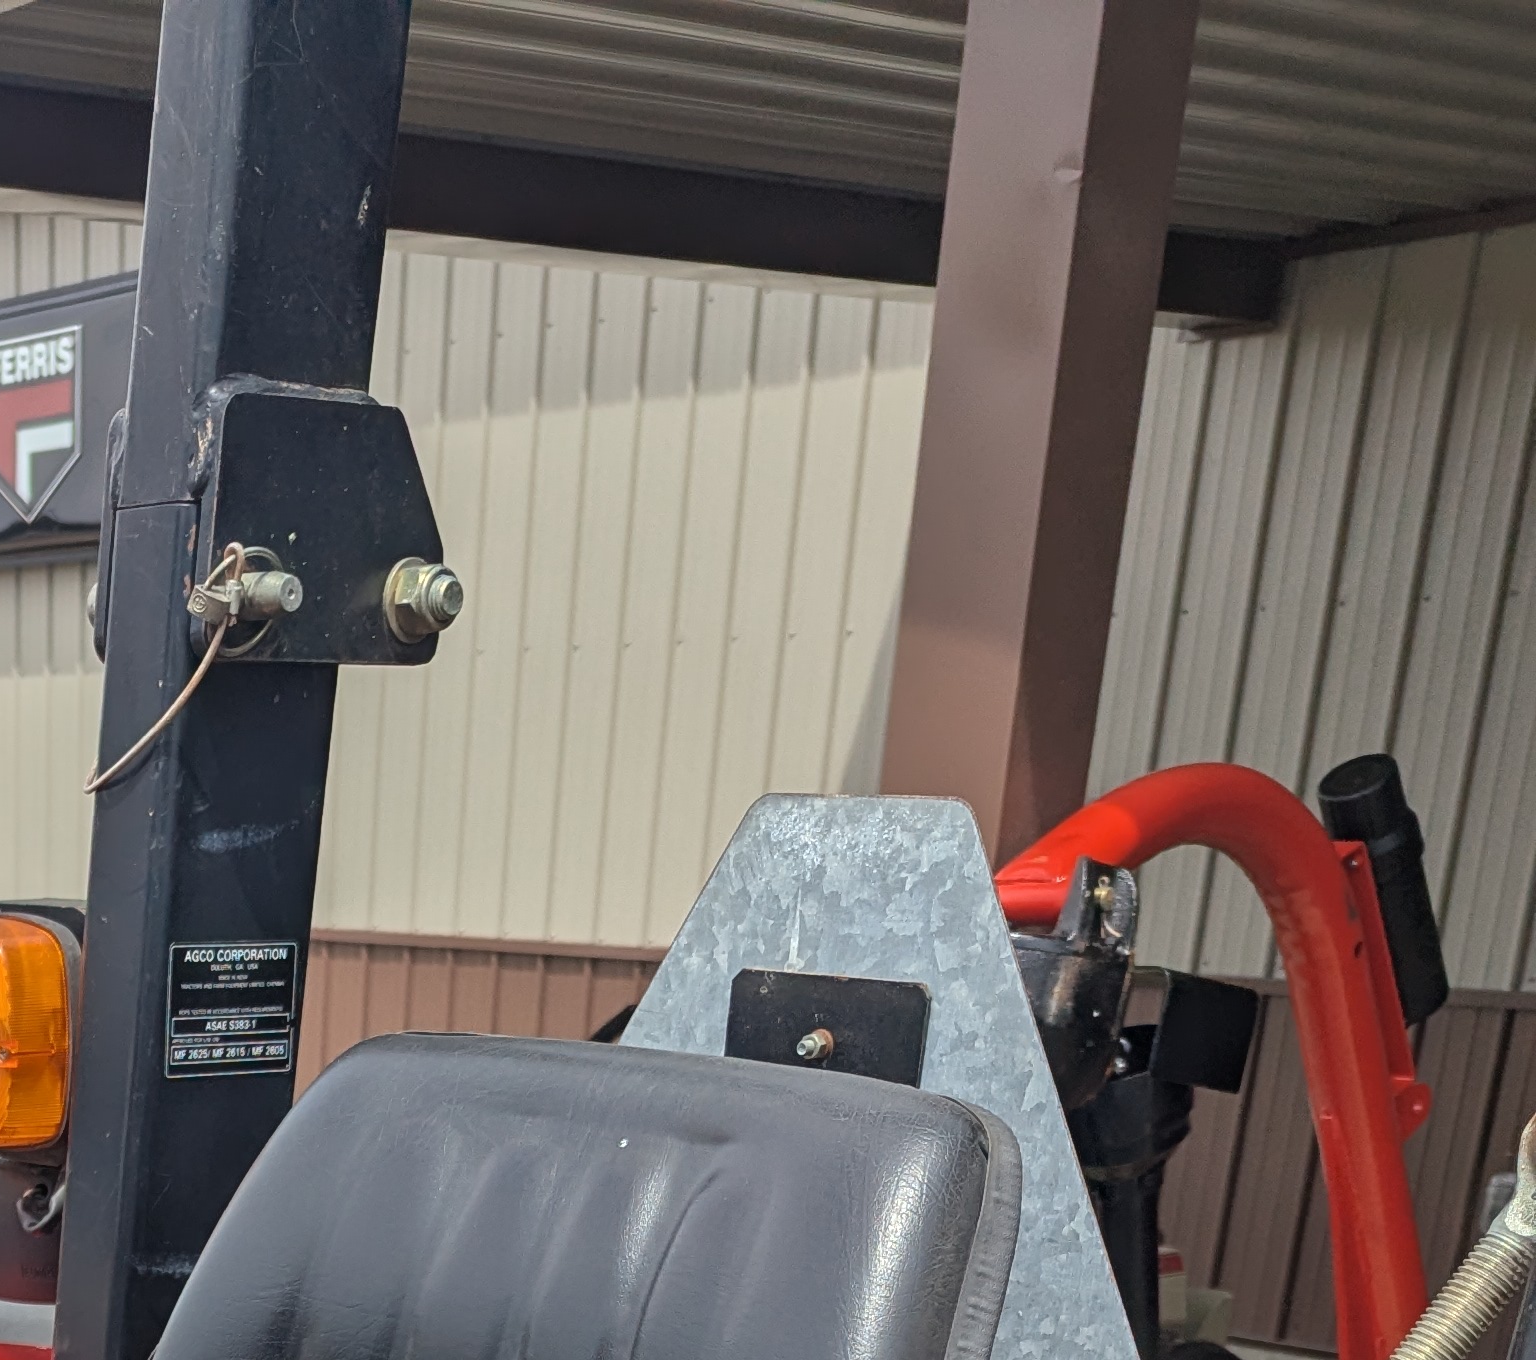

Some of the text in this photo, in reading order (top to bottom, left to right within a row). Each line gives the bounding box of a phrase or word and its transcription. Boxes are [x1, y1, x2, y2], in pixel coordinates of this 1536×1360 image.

[184, 948, 287, 962] AGCO CORPORATION
[205, 1019, 257, 1031] ASAE S383-1
[174, 1050, 187, 1060] MF
[212, 1048, 224, 1058] MF
[252, 1046, 264, 1056] MF
